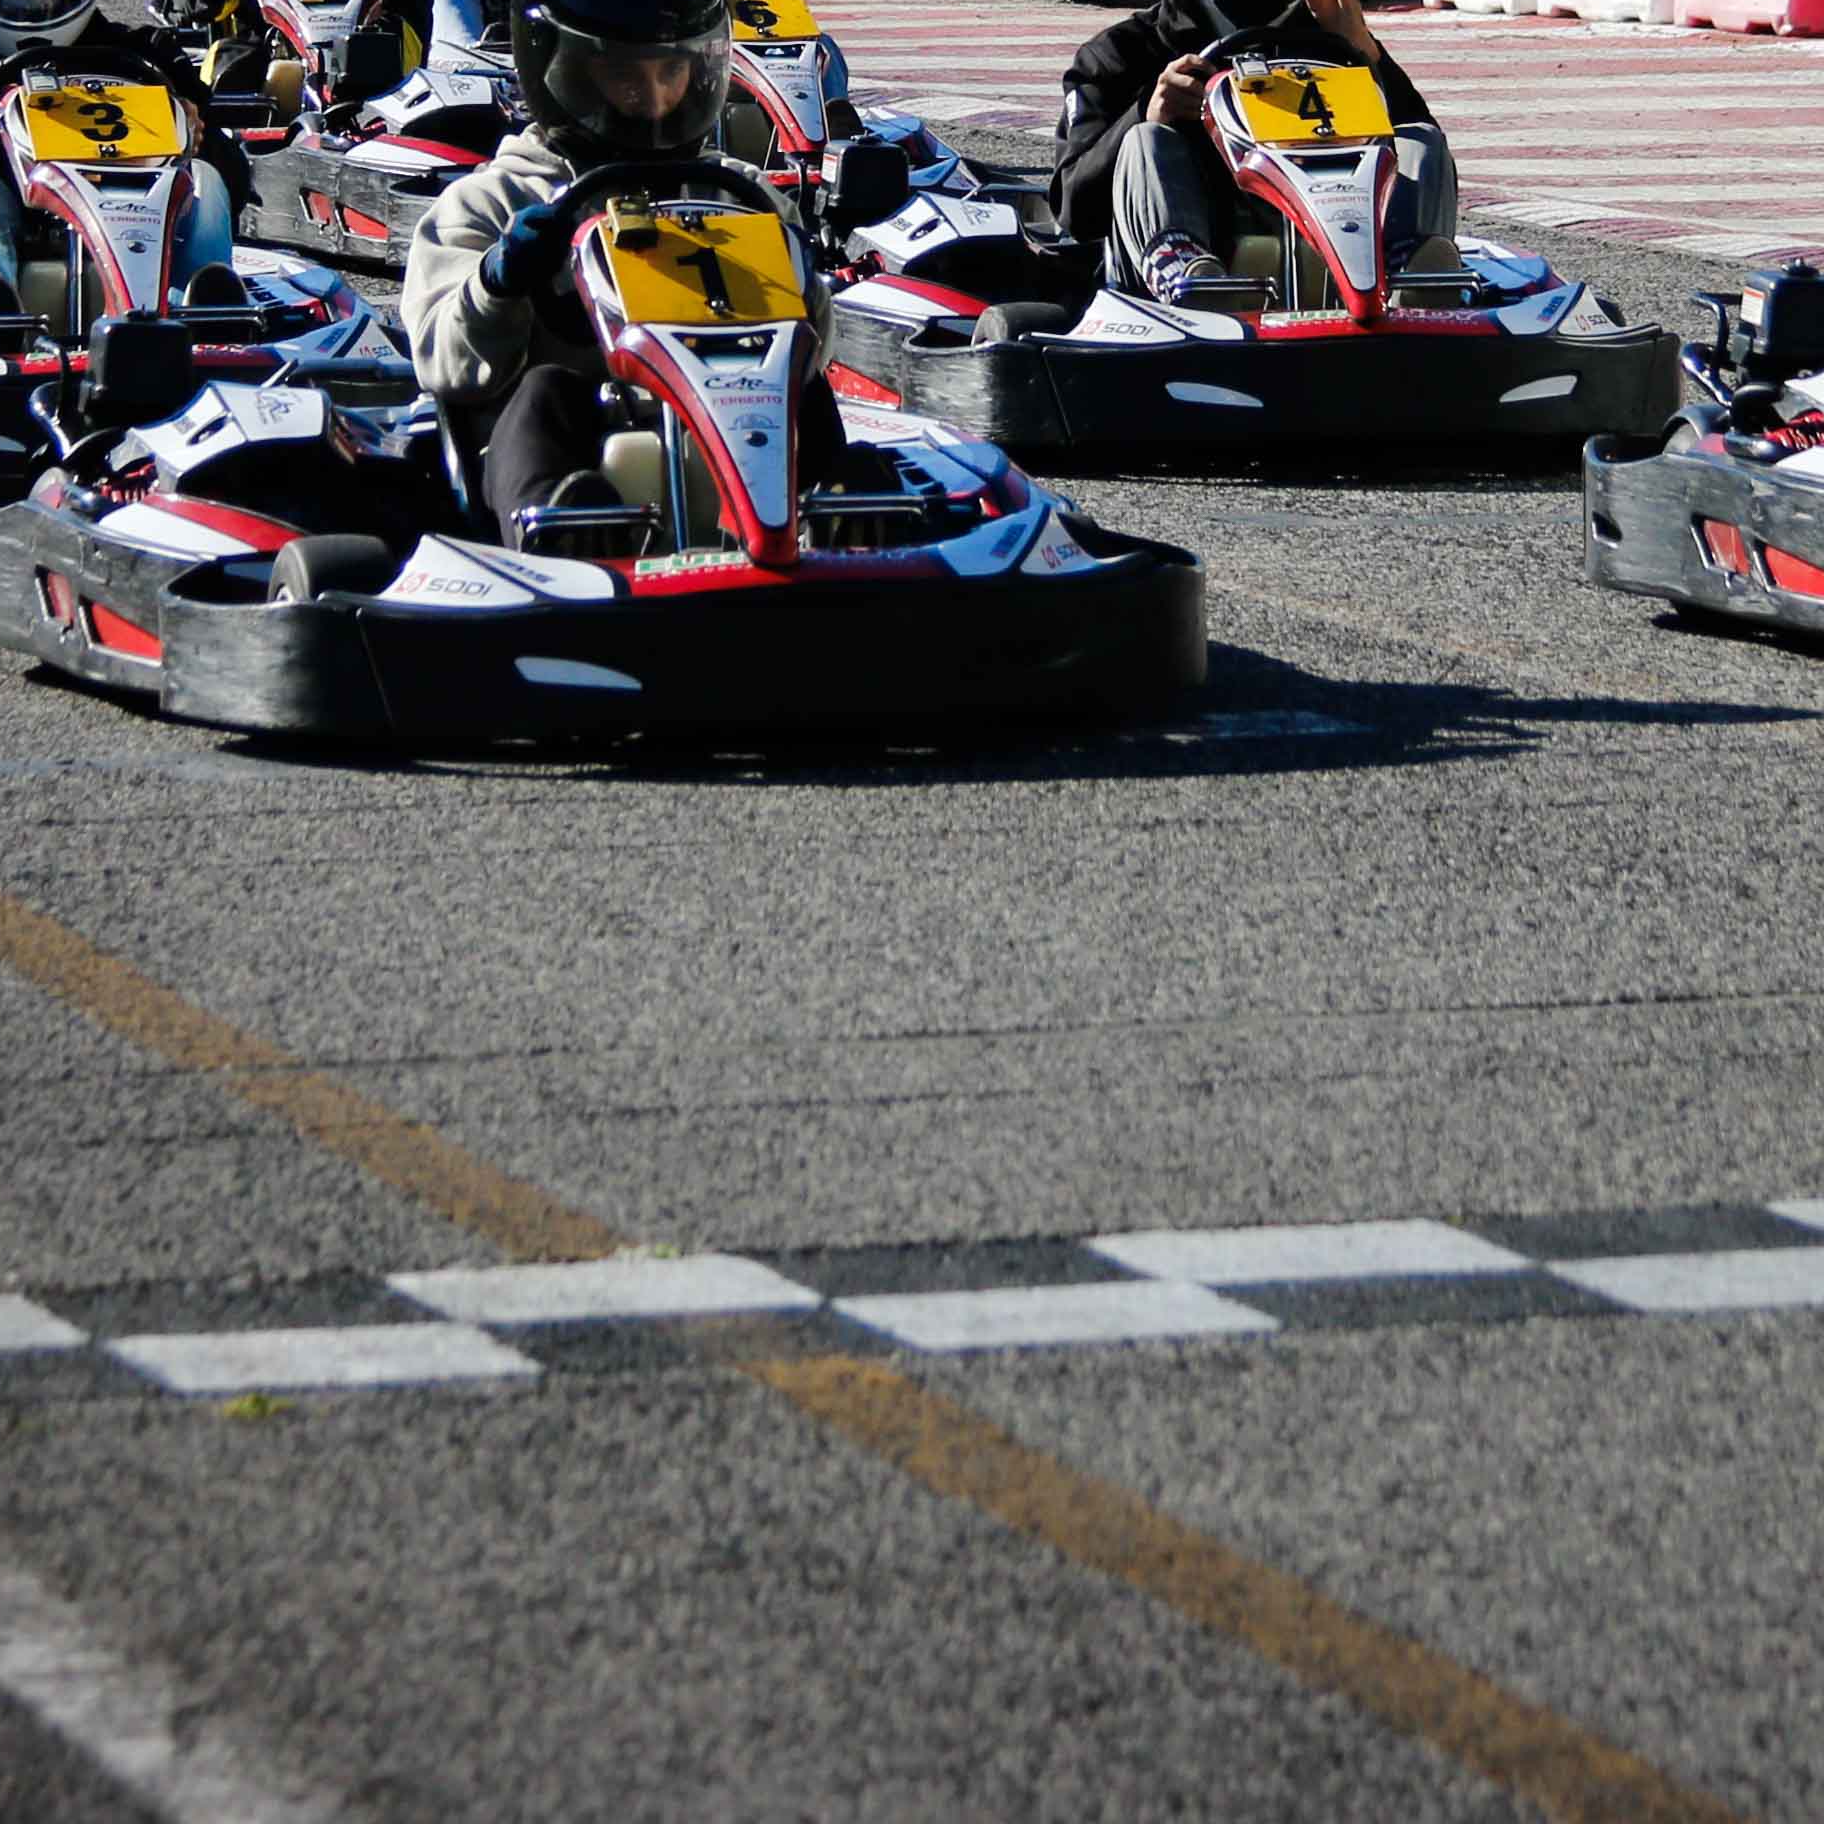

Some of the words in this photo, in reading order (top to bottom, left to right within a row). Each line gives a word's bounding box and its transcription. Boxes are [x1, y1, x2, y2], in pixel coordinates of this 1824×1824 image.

[78, 103, 129, 141] 3
[1299, 80, 1335, 129] 4
[678, 246, 732, 313] 1
[1102, 322, 1152, 336] SODI
[426, 576, 493, 598] SODI
